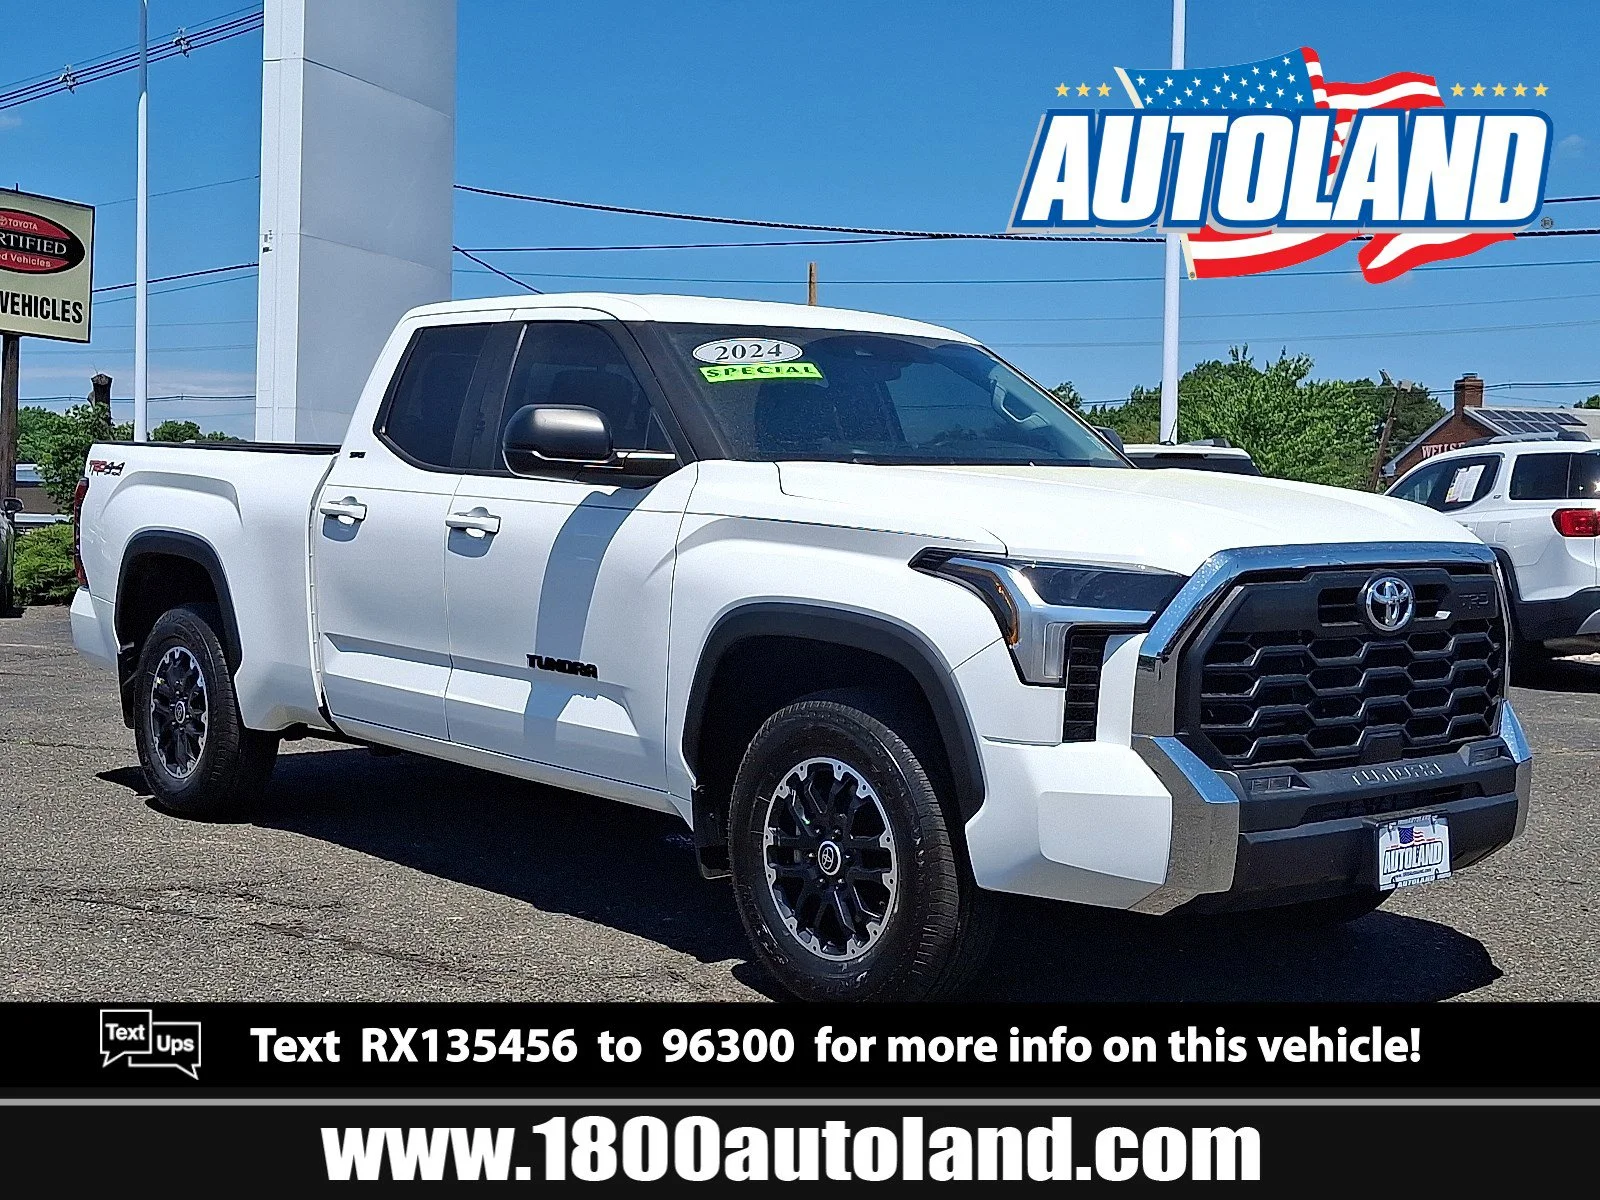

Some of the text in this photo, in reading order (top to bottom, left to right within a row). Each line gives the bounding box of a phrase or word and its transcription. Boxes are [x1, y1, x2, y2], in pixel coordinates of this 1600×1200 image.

[9, 219, 38, 231] TOYOTA
[10, 253, 51, 268] Vehicles
[0, 290, 83, 324] VEHICLES
[714, 343, 782, 361] 2024
[706, 366, 816, 377] SPECIAL
[526, 653, 598, 679] TUNDRA
[1383, 841, 1444, 875] AUTOLAND
